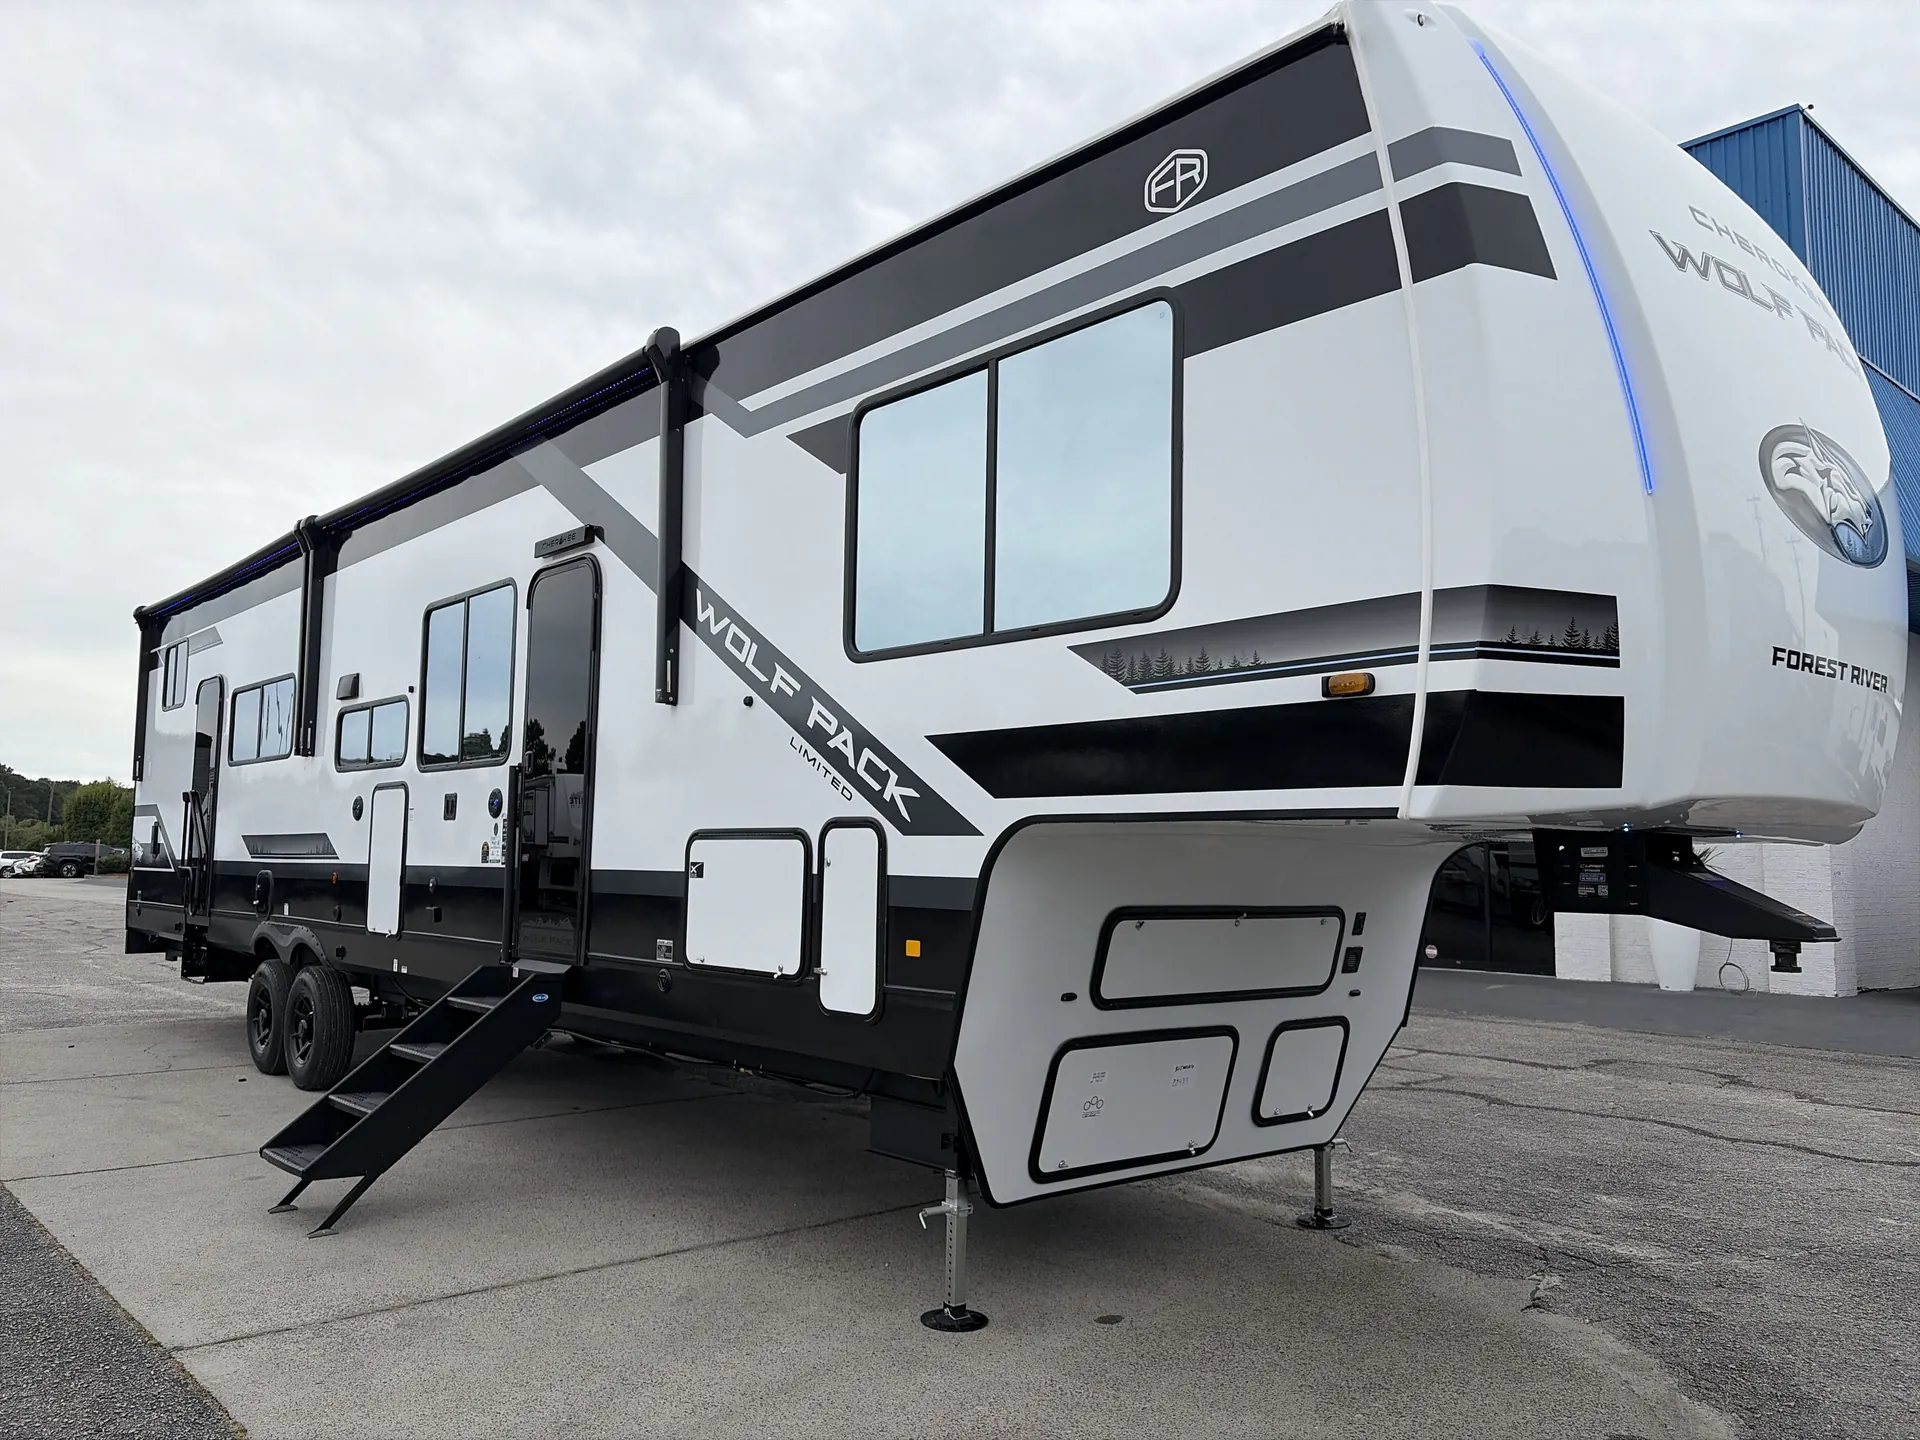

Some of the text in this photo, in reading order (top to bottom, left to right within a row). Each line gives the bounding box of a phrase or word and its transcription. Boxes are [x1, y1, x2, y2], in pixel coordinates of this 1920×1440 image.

[1648, 228, 1795, 321] WOLF
[695, 587, 921, 823] WOLF PACK
[1771, 645, 1888, 693] FOREST RIVER
[788, 735, 854, 802] LIMITED
